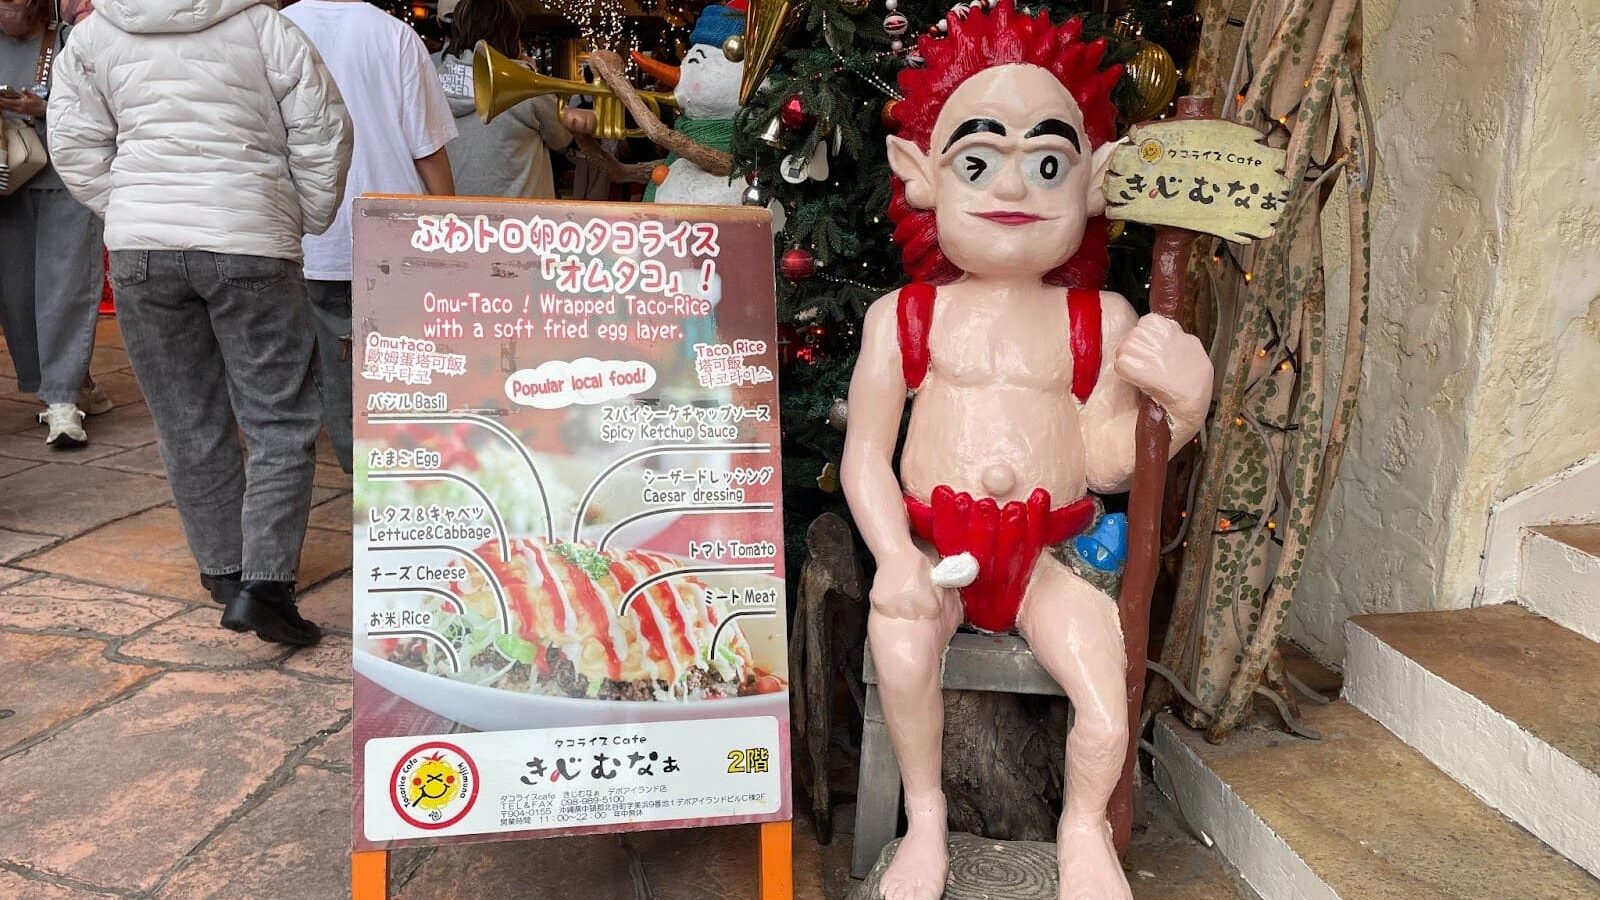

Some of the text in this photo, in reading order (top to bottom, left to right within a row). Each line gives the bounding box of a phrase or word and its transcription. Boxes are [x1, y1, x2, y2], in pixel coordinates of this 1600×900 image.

[414, 216, 720, 256] ふわトロ卵のタコライス
[423, 292, 513, 314] Omu-Taco
[540, 293, 616, 317] Wrapped
[624, 295, 712, 316] Taco-Rice
[423, 317, 684, 342] with a soft fried egg layer.
[369, 333, 434, 353] Omutaco
[695, 341, 765, 358] Taco Rice
[512, 367, 646, 397] Popular local food!
[368, 393, 446, 409] バジル Basil
[602, 405, 770, 422] スパイシーケチャップソース
[601, 423, 737, 441] Spicy Ketchup Sauce
[370, 450, 439, 467] たまご Egg
[643, 469, 773, 486] シーザードレッシング
[643, 488, 744, 504] Caesar dressing
[369, 525, 492, 542] Lettuce&Cabbage
[691, 541, 775, 558] トマト Tomato
[370, 565, 466, 582] チーズ Cheese
[705, 588, 776, 604] ミート Meat
[370, 610, 431, 627] お米 Rice
[727, 747, 769, 774] 2階
